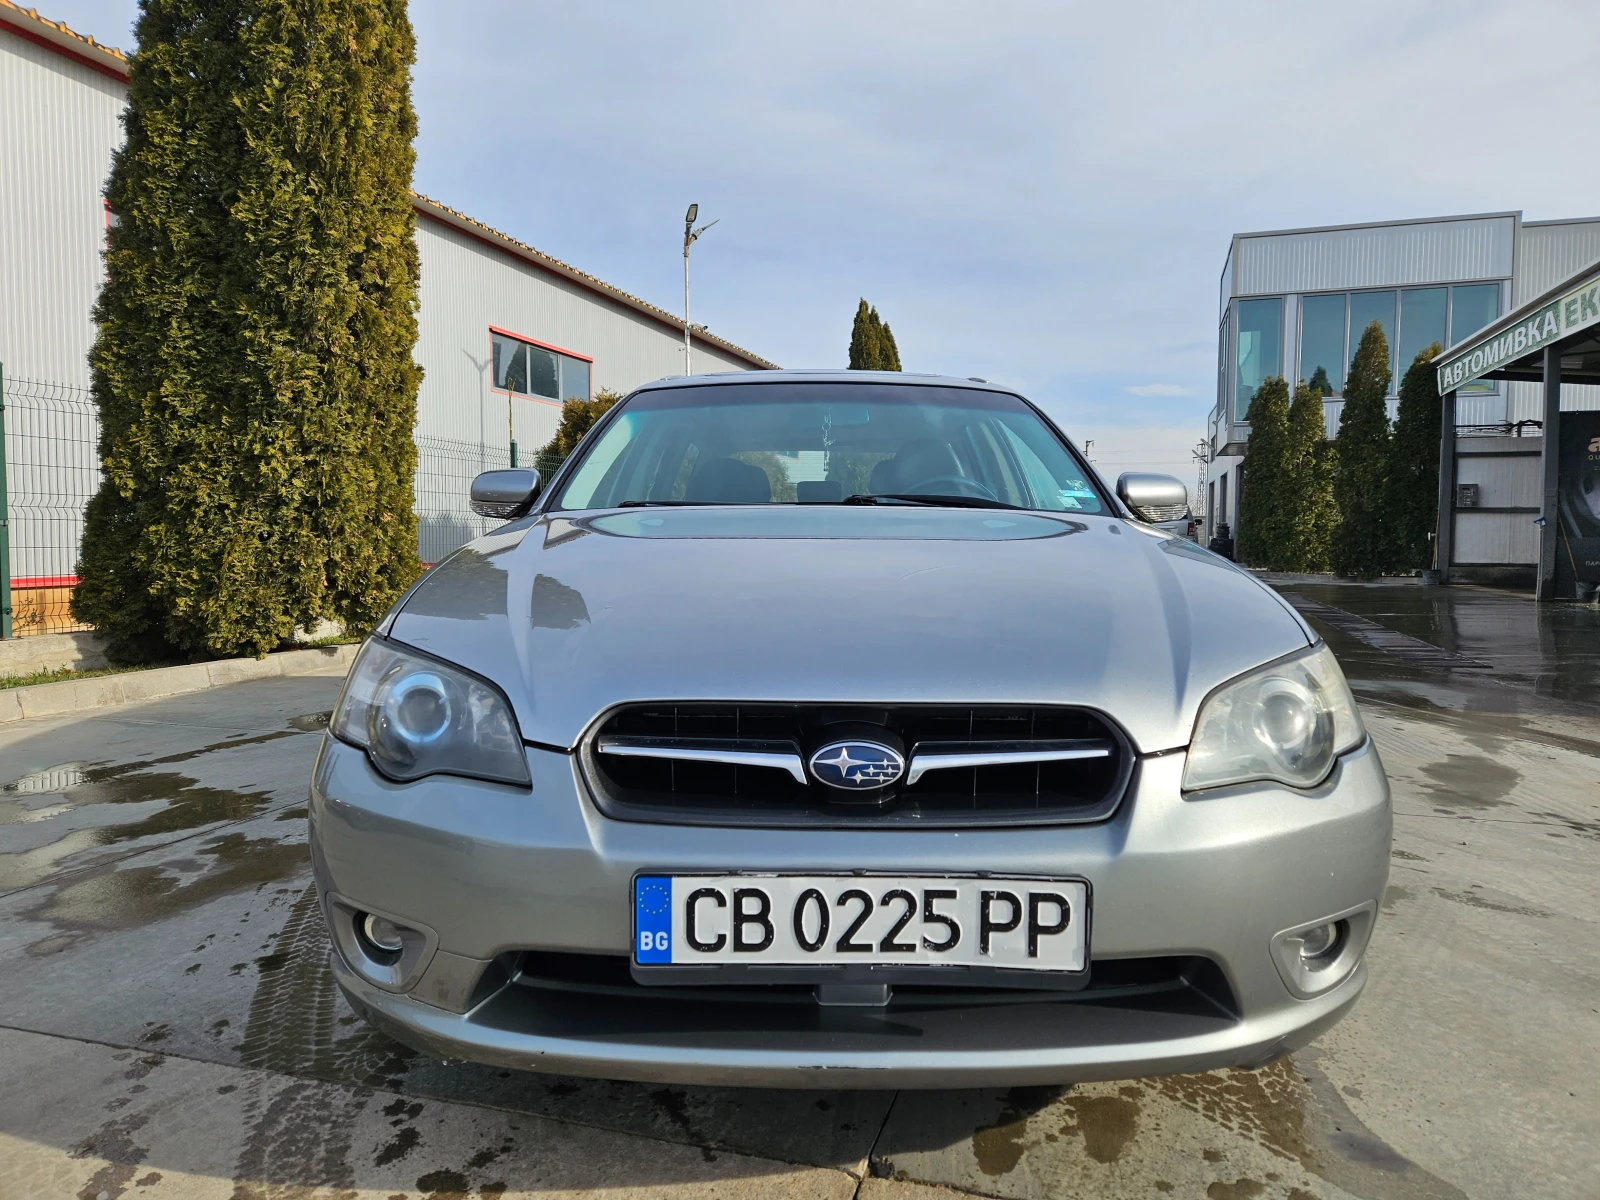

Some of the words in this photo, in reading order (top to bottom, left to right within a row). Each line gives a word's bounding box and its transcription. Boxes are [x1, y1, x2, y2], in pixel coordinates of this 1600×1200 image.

[1443, 310, 1558, 388] АВТОМИВКА
[1564, 285, 1600, 329] ЕК
[640, 931, 669, 951] BG
[687, 887, 775, 952] CB
[793, 888, 961, 952] 0225
[979, 890, 1071, 958] PP
